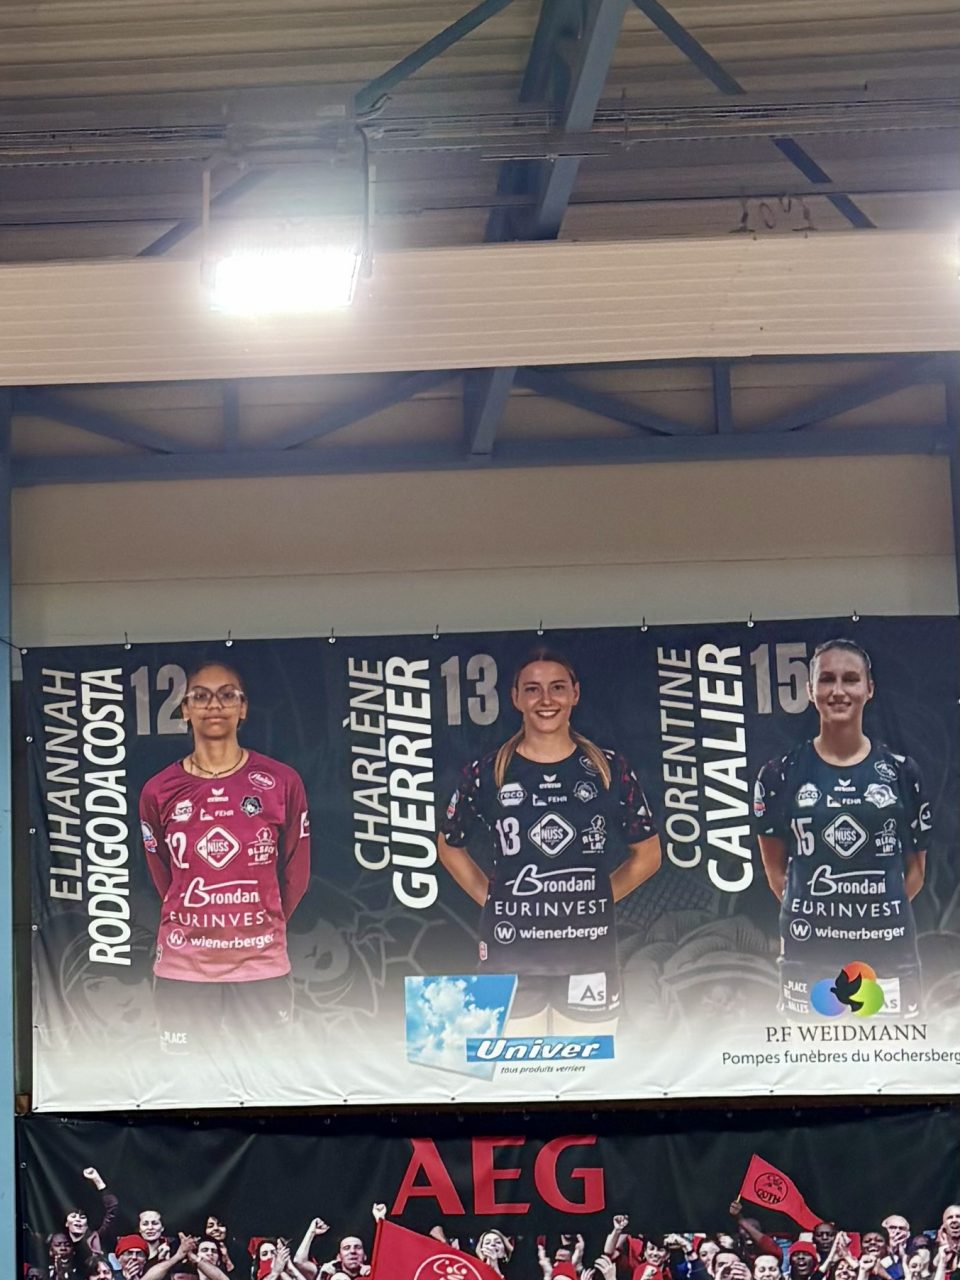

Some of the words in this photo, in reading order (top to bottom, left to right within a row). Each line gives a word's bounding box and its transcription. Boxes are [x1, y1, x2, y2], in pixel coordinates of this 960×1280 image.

[750, 642, 809, 715] 15
[130, 664, 189, 735] 12
[440, 654, 500, 727] 13
[343, 657, 390, 871] CHARLÈNE
[657, 647, 701, 869] CORENTINE
[698, 642, 754, 893] CAVALIER
[42, 668, 83, 902] ELIHANNAH
[385, 656, 439, 910] GUERRIER
[541, 828, 564, 839] NUSS
[835, 829, 857, 842] NUSS
[207, 841, 229, 852] NUSS
[505, 864, 596, 896] Brondani
[180, 877, 261, 908] Brondan
[494, 898, 608, 917] EURINVEST
[791, 898, 902, 918] EURINVEST
[519, 925, 609, 941] wienerberger
[815, 926, 905, 941] wienerberger
[580, 985, 605, 1002] As
[766, 1026, 792, 1043] P.F
[798, 1024, 927, 1042] WEIDMANN
[476, 1038, 600, 1060] Univer
[722, 1051, 781, 1067] Pompes
[784, 1050, 848, 1064] funèbres
[851, 1049, 870, 1063] du
[500, 1066, 518, 1074] tous
[519, 1066, 554, 1075] produits
[555, 1065, 586, 1073] verriers
[391, 1134, 605, 1216] AEG
